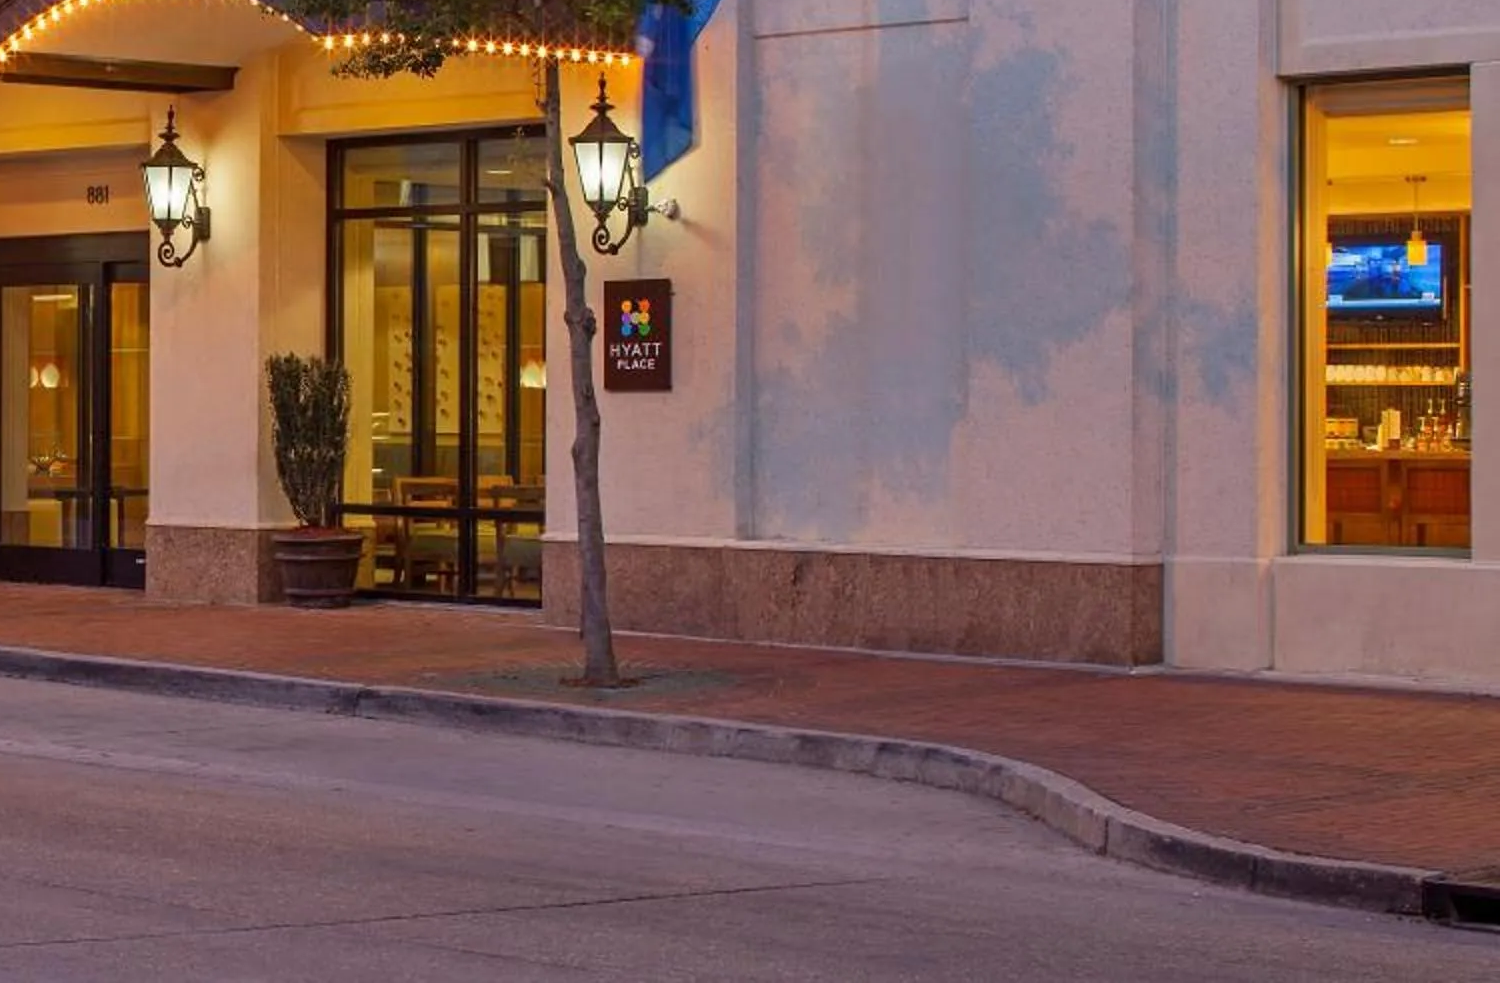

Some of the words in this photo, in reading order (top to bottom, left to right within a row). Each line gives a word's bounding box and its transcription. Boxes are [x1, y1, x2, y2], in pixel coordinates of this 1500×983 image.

[87, 185, 109, 205] 881
[610, 342, 661, 357] HYATT
[617, 358, 655, 370] PLACE
